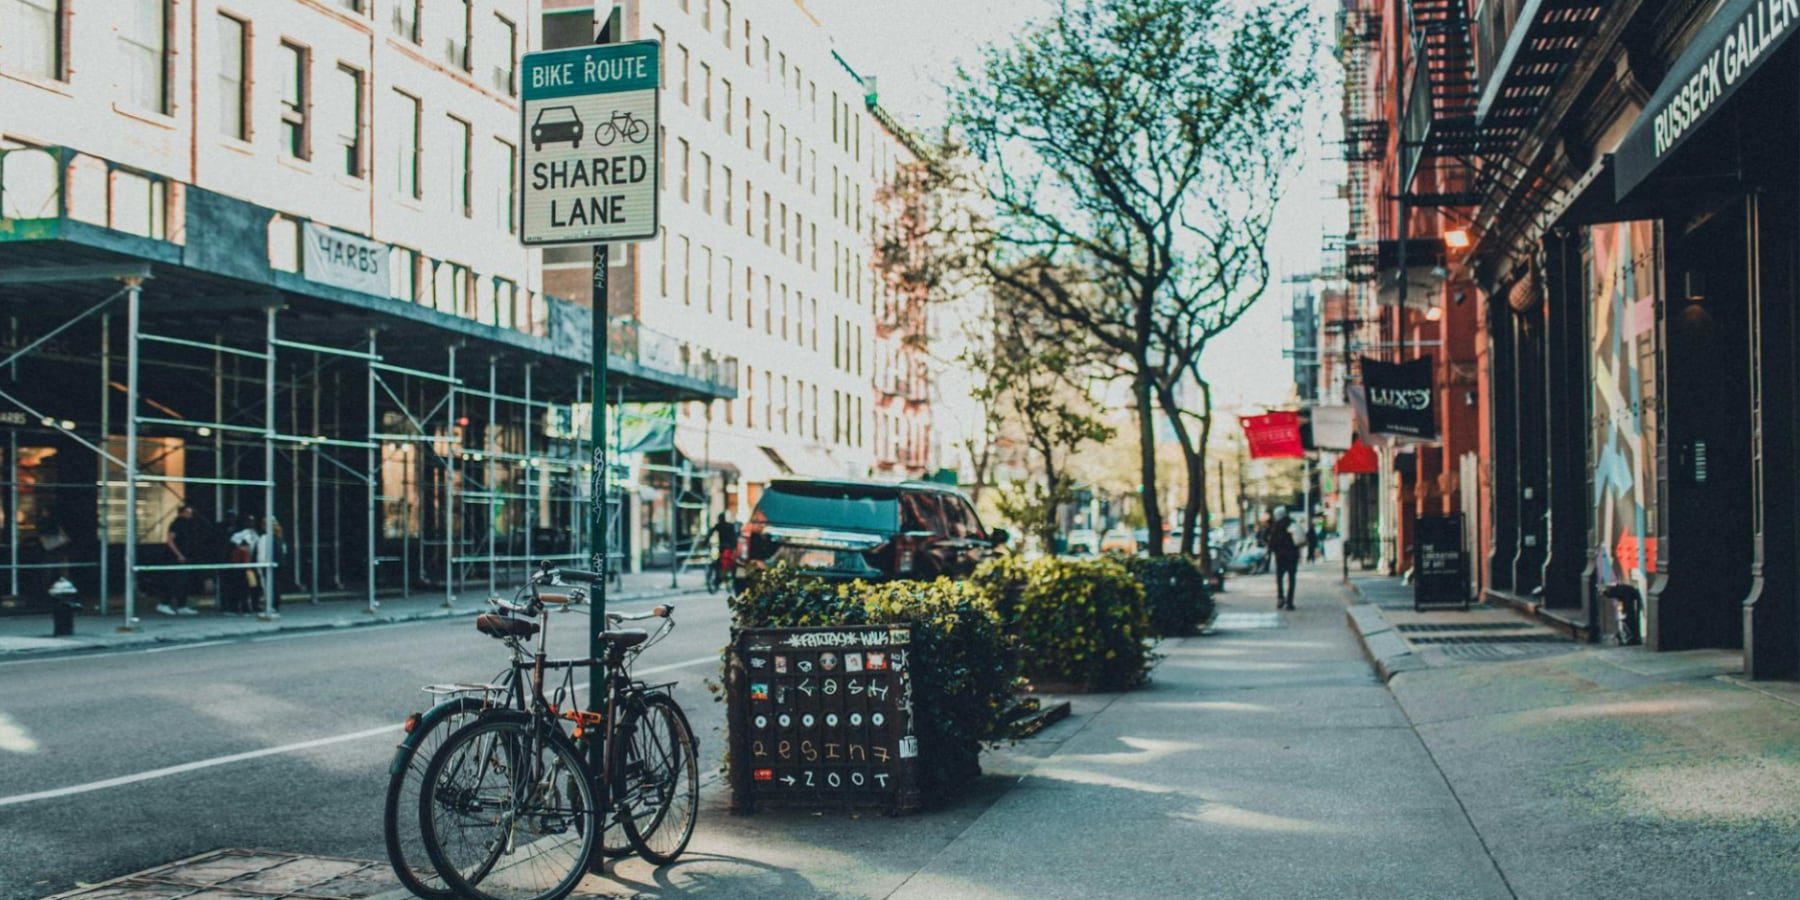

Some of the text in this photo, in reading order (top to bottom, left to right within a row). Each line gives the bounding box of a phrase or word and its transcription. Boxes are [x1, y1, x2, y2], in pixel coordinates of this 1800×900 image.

[532, 56, 648, 88] BIKE ROUTE
[1654, 50, 1722, 158] RUSSECK
[532, 155, 647, 190] SHARED
[551, 195, 626, 228] LANE
[318, 234, 378, 274] HARBS
